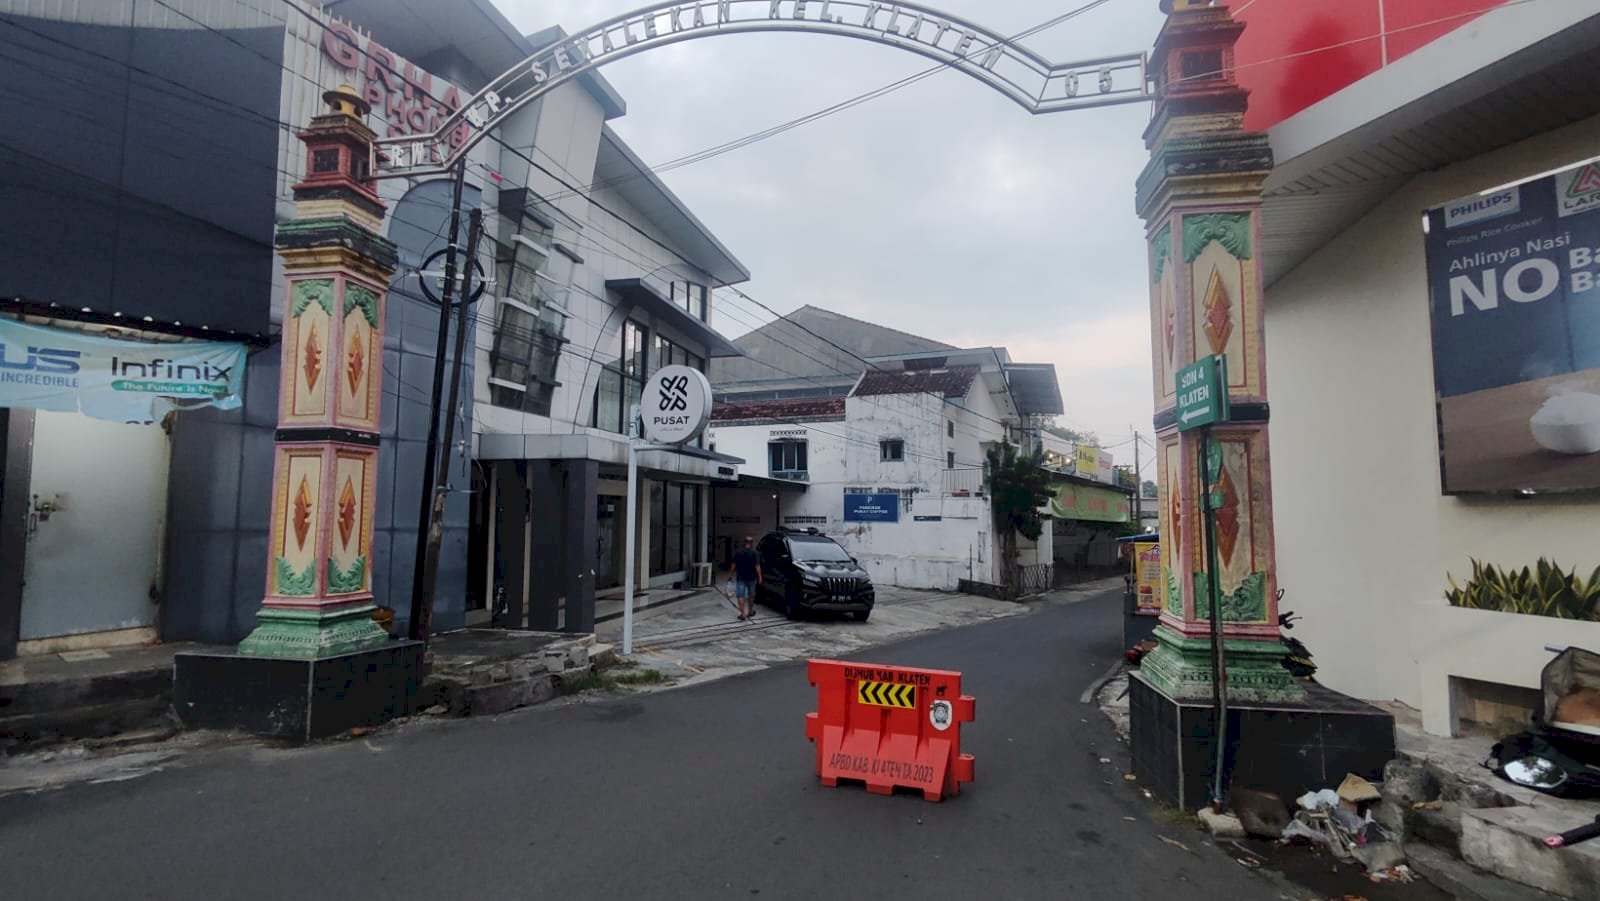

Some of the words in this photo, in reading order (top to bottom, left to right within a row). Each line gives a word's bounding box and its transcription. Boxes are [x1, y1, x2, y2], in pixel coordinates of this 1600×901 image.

[863, 2, 1005, 71] KLATEN
[1450, 192, 1513, 219] PHILIPS
[1449, 245, 1521, 273] Ahlinya
[1525, 231, 1571, 254] Nasi
[1448, 257, 1560, 317] NO
[1, 373, 79, 388] INCREDIBLE
[111, 356, 233, 382] Infinix
[1181, 368, 1198, 389] SDN
[1198, 365, 1205, 381] 4
[122, 381, 143, 391] The
[147, 382, 183, 393] Future
[1179, 384, 1209, 409] KLATEN
[653, 415, 691, 426] PUSAT
[912, 764, 934, 784] 2023
